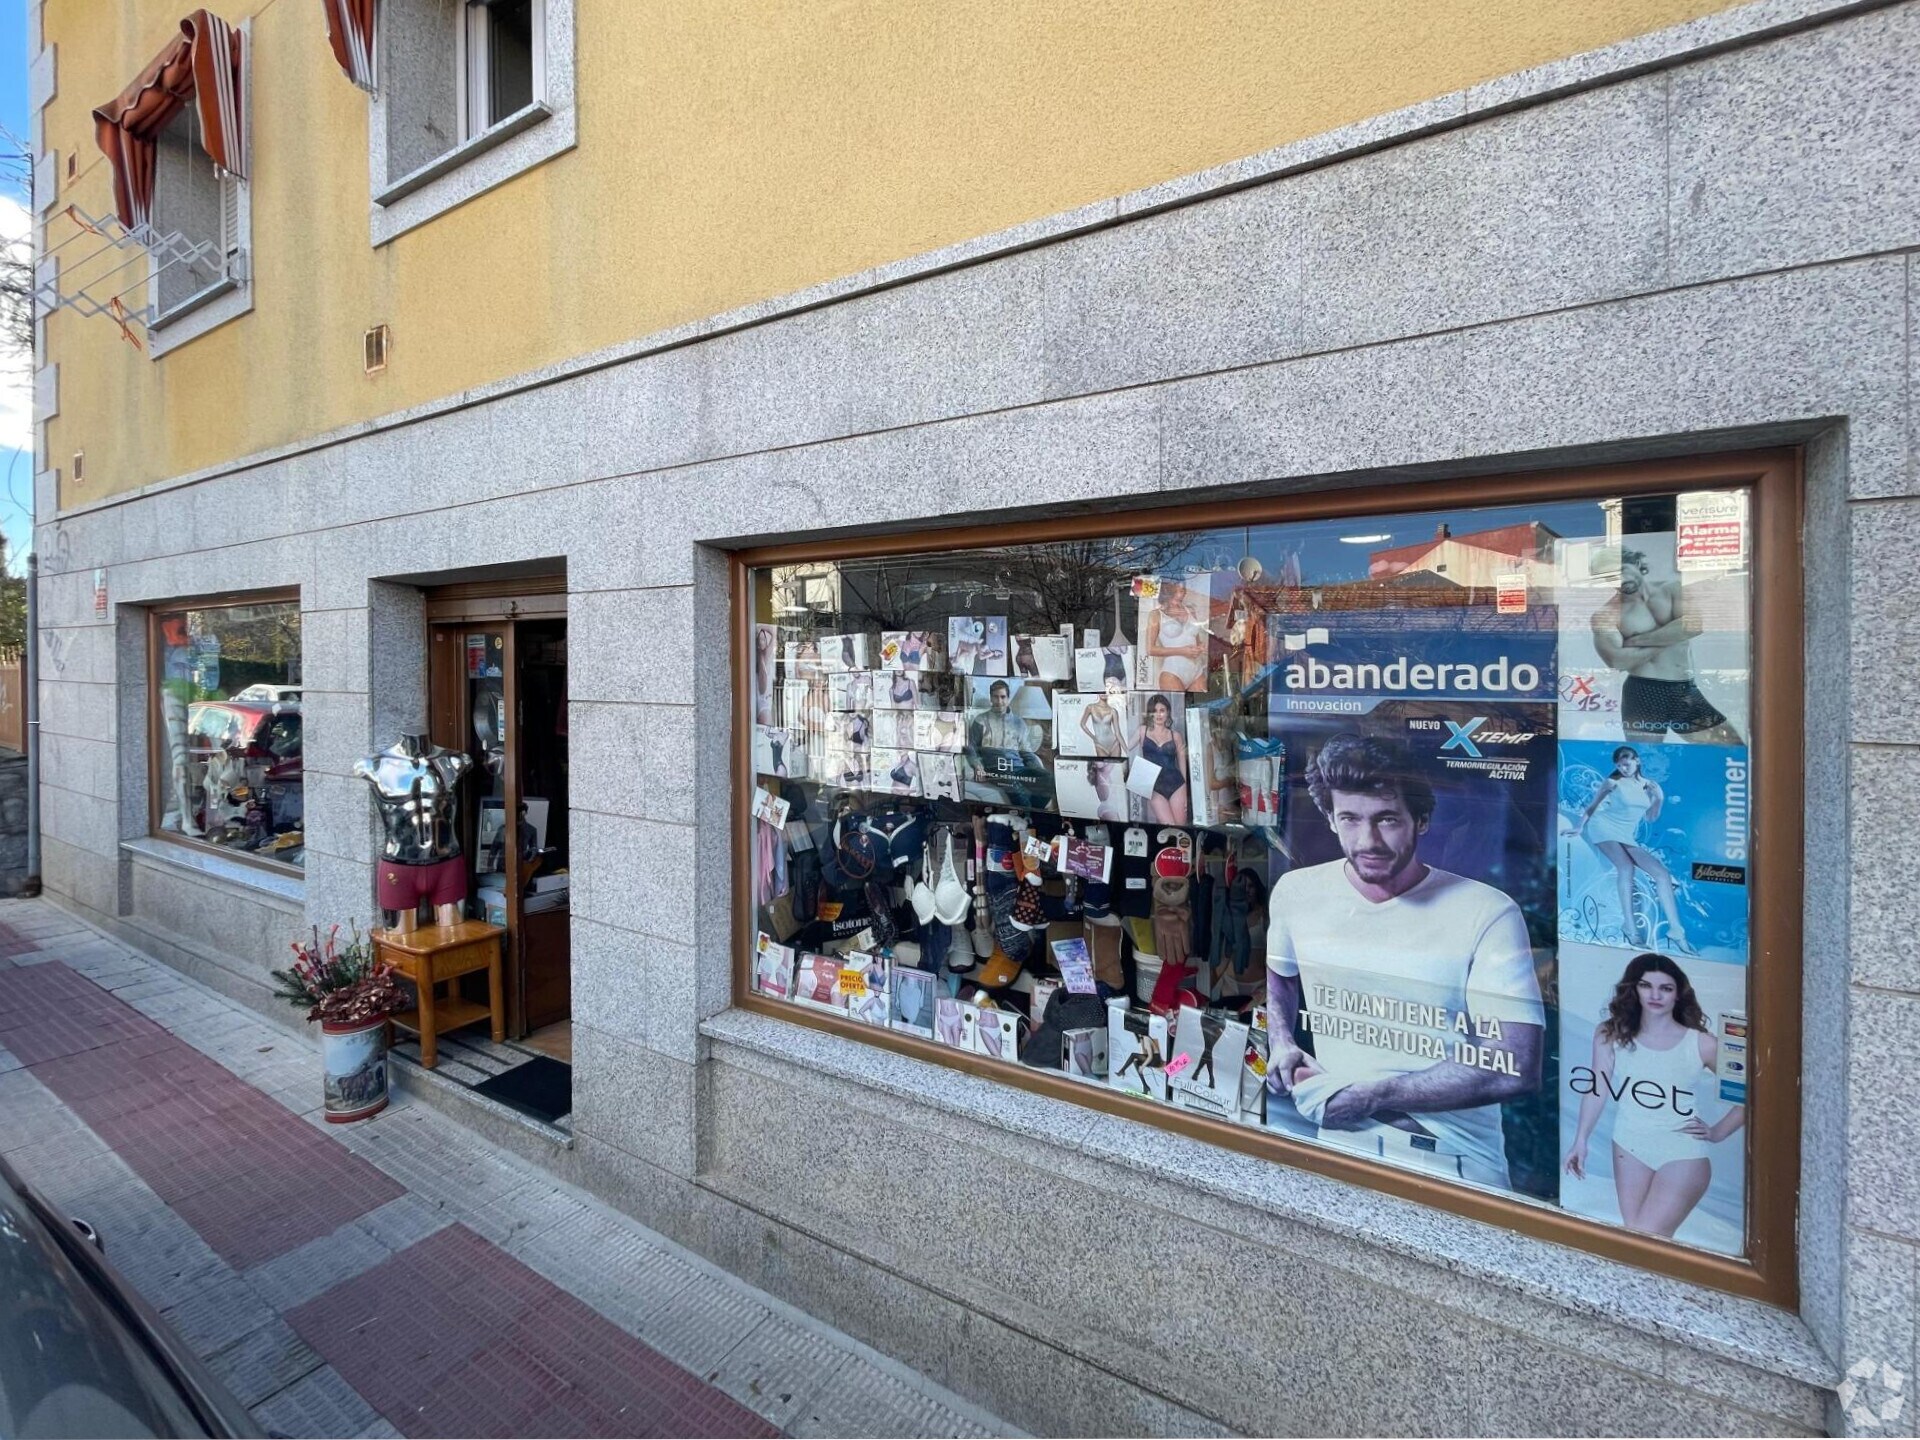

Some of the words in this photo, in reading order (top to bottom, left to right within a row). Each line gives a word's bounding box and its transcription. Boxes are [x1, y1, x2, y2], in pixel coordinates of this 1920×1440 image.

[1682, 505, 1738, 515] verisure
[1681, 526, 1739, 536] Alarma
[1139, 655, 1149, 684] Selene
[1285, 656, 1539, 691] abanderado
[1060, 697, 1081, 705] Selene
[1409, 720, 1441, 730] NUEVO
[1057, 762, 1078, 770] Selene
[1191, 752, 1201, 783] Selene
[1446, 761, 1527, 772] TERMORREGULACIÓN
[1488, 770, 1525, 780] ACTIVA
[1725, 757, 1746, 861] summer
[832, 917, 872, 931] isotone
[840, 974, 863, 983] PRECIO
[840, 982, 865, 990] OFERTA
[1313, 984, 1336, 1008] TE
[1341, 989, 1447, 1031] MANTIENE
[1453, 1011, 1469, 1036] A
[1475, 1014, 1503, 1041] LA
[1299, 1009, 1447, 1061] TEMPERATURA
[1454, 1042, 1521, 1077] IDEAL
[1173, 1077, 1192, 1091] Full
[1194, 1084, 1231, 1107] Colour
[1569, 1066, 1694, 1117] avet
